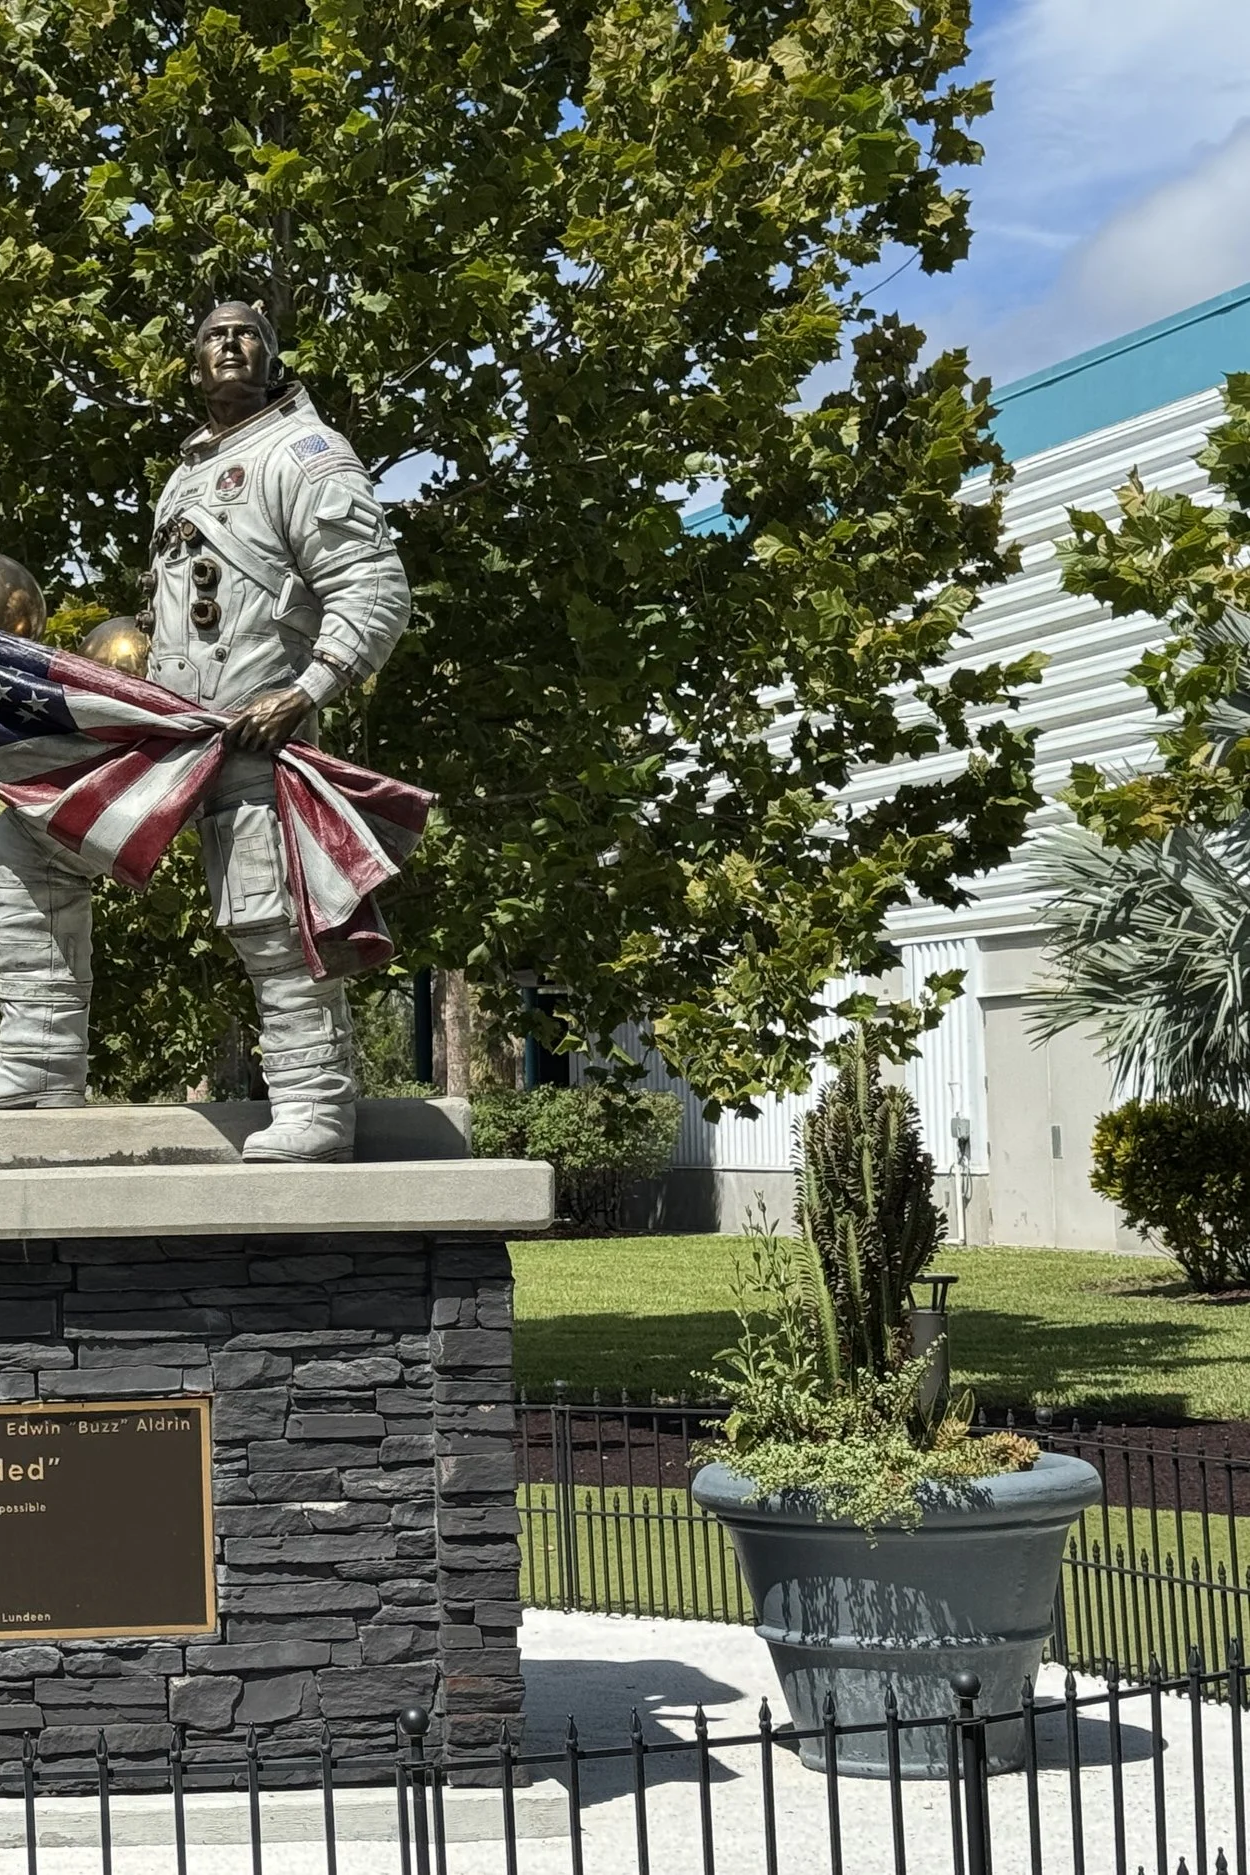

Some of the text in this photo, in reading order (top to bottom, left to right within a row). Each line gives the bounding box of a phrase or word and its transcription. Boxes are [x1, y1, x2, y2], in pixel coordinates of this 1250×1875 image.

[6, 1420, 61, 1436] Edwin
[136, 1416, 191, 1432] Aldrin
[2, 1612, 51, 1623] Lundeen
